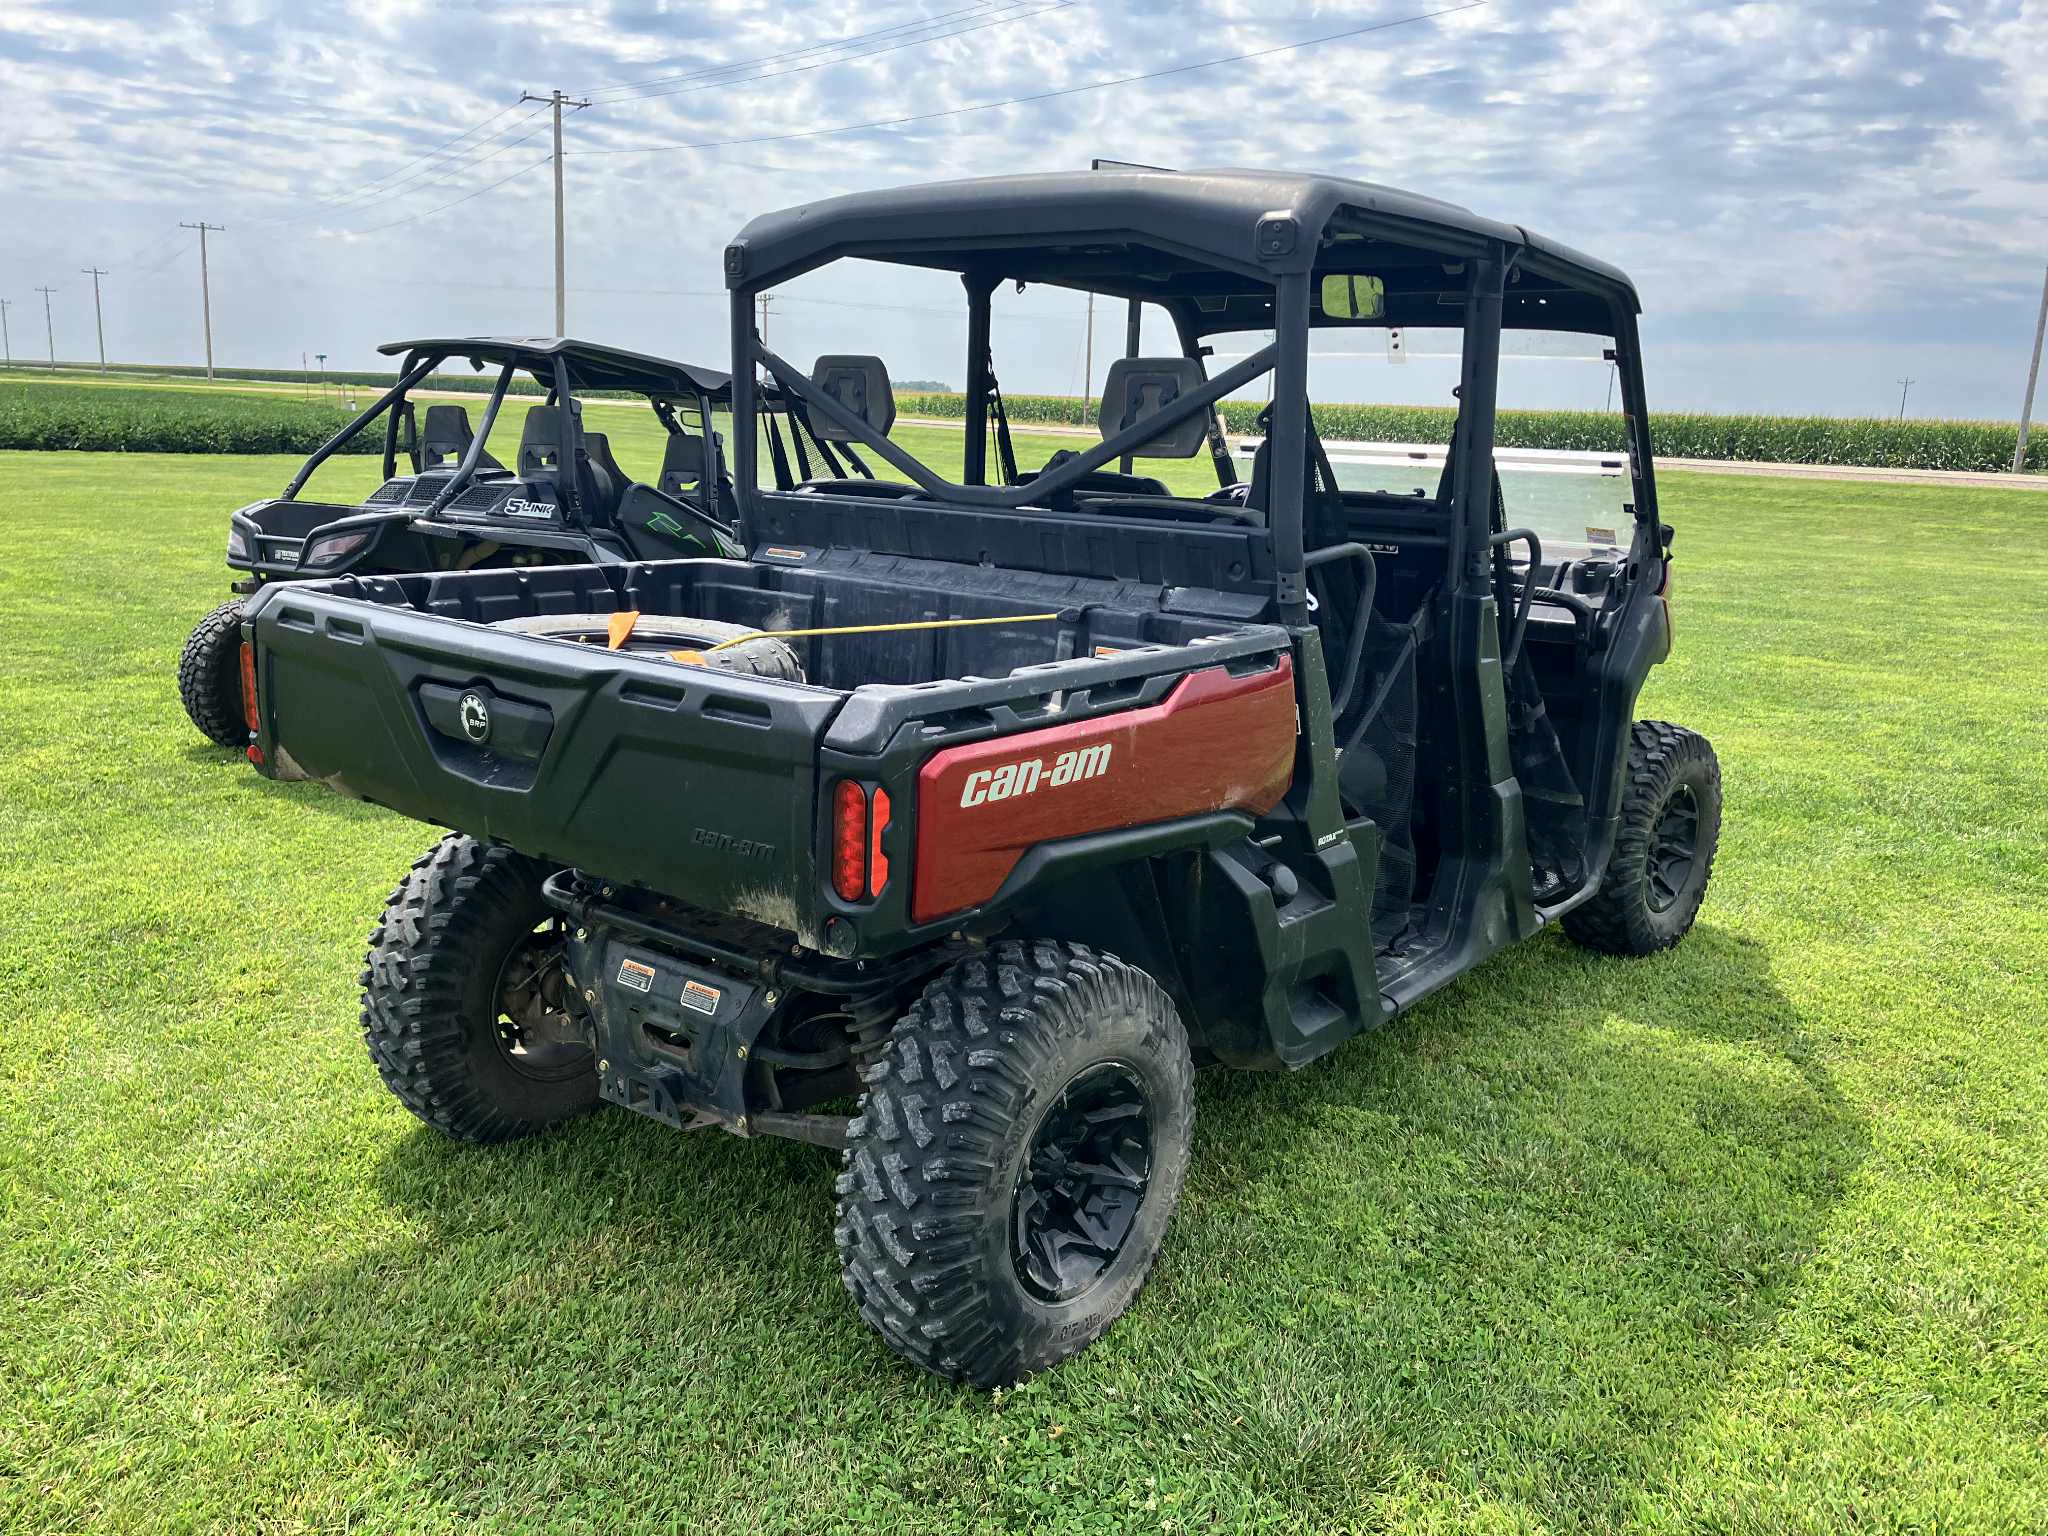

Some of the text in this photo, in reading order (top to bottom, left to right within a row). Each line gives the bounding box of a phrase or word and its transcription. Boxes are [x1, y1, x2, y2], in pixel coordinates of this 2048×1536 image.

[469, 718, 486, 728] BRP
[960, 743, 1112, 808] can-am
[693, 827, 776, 861] can-am
